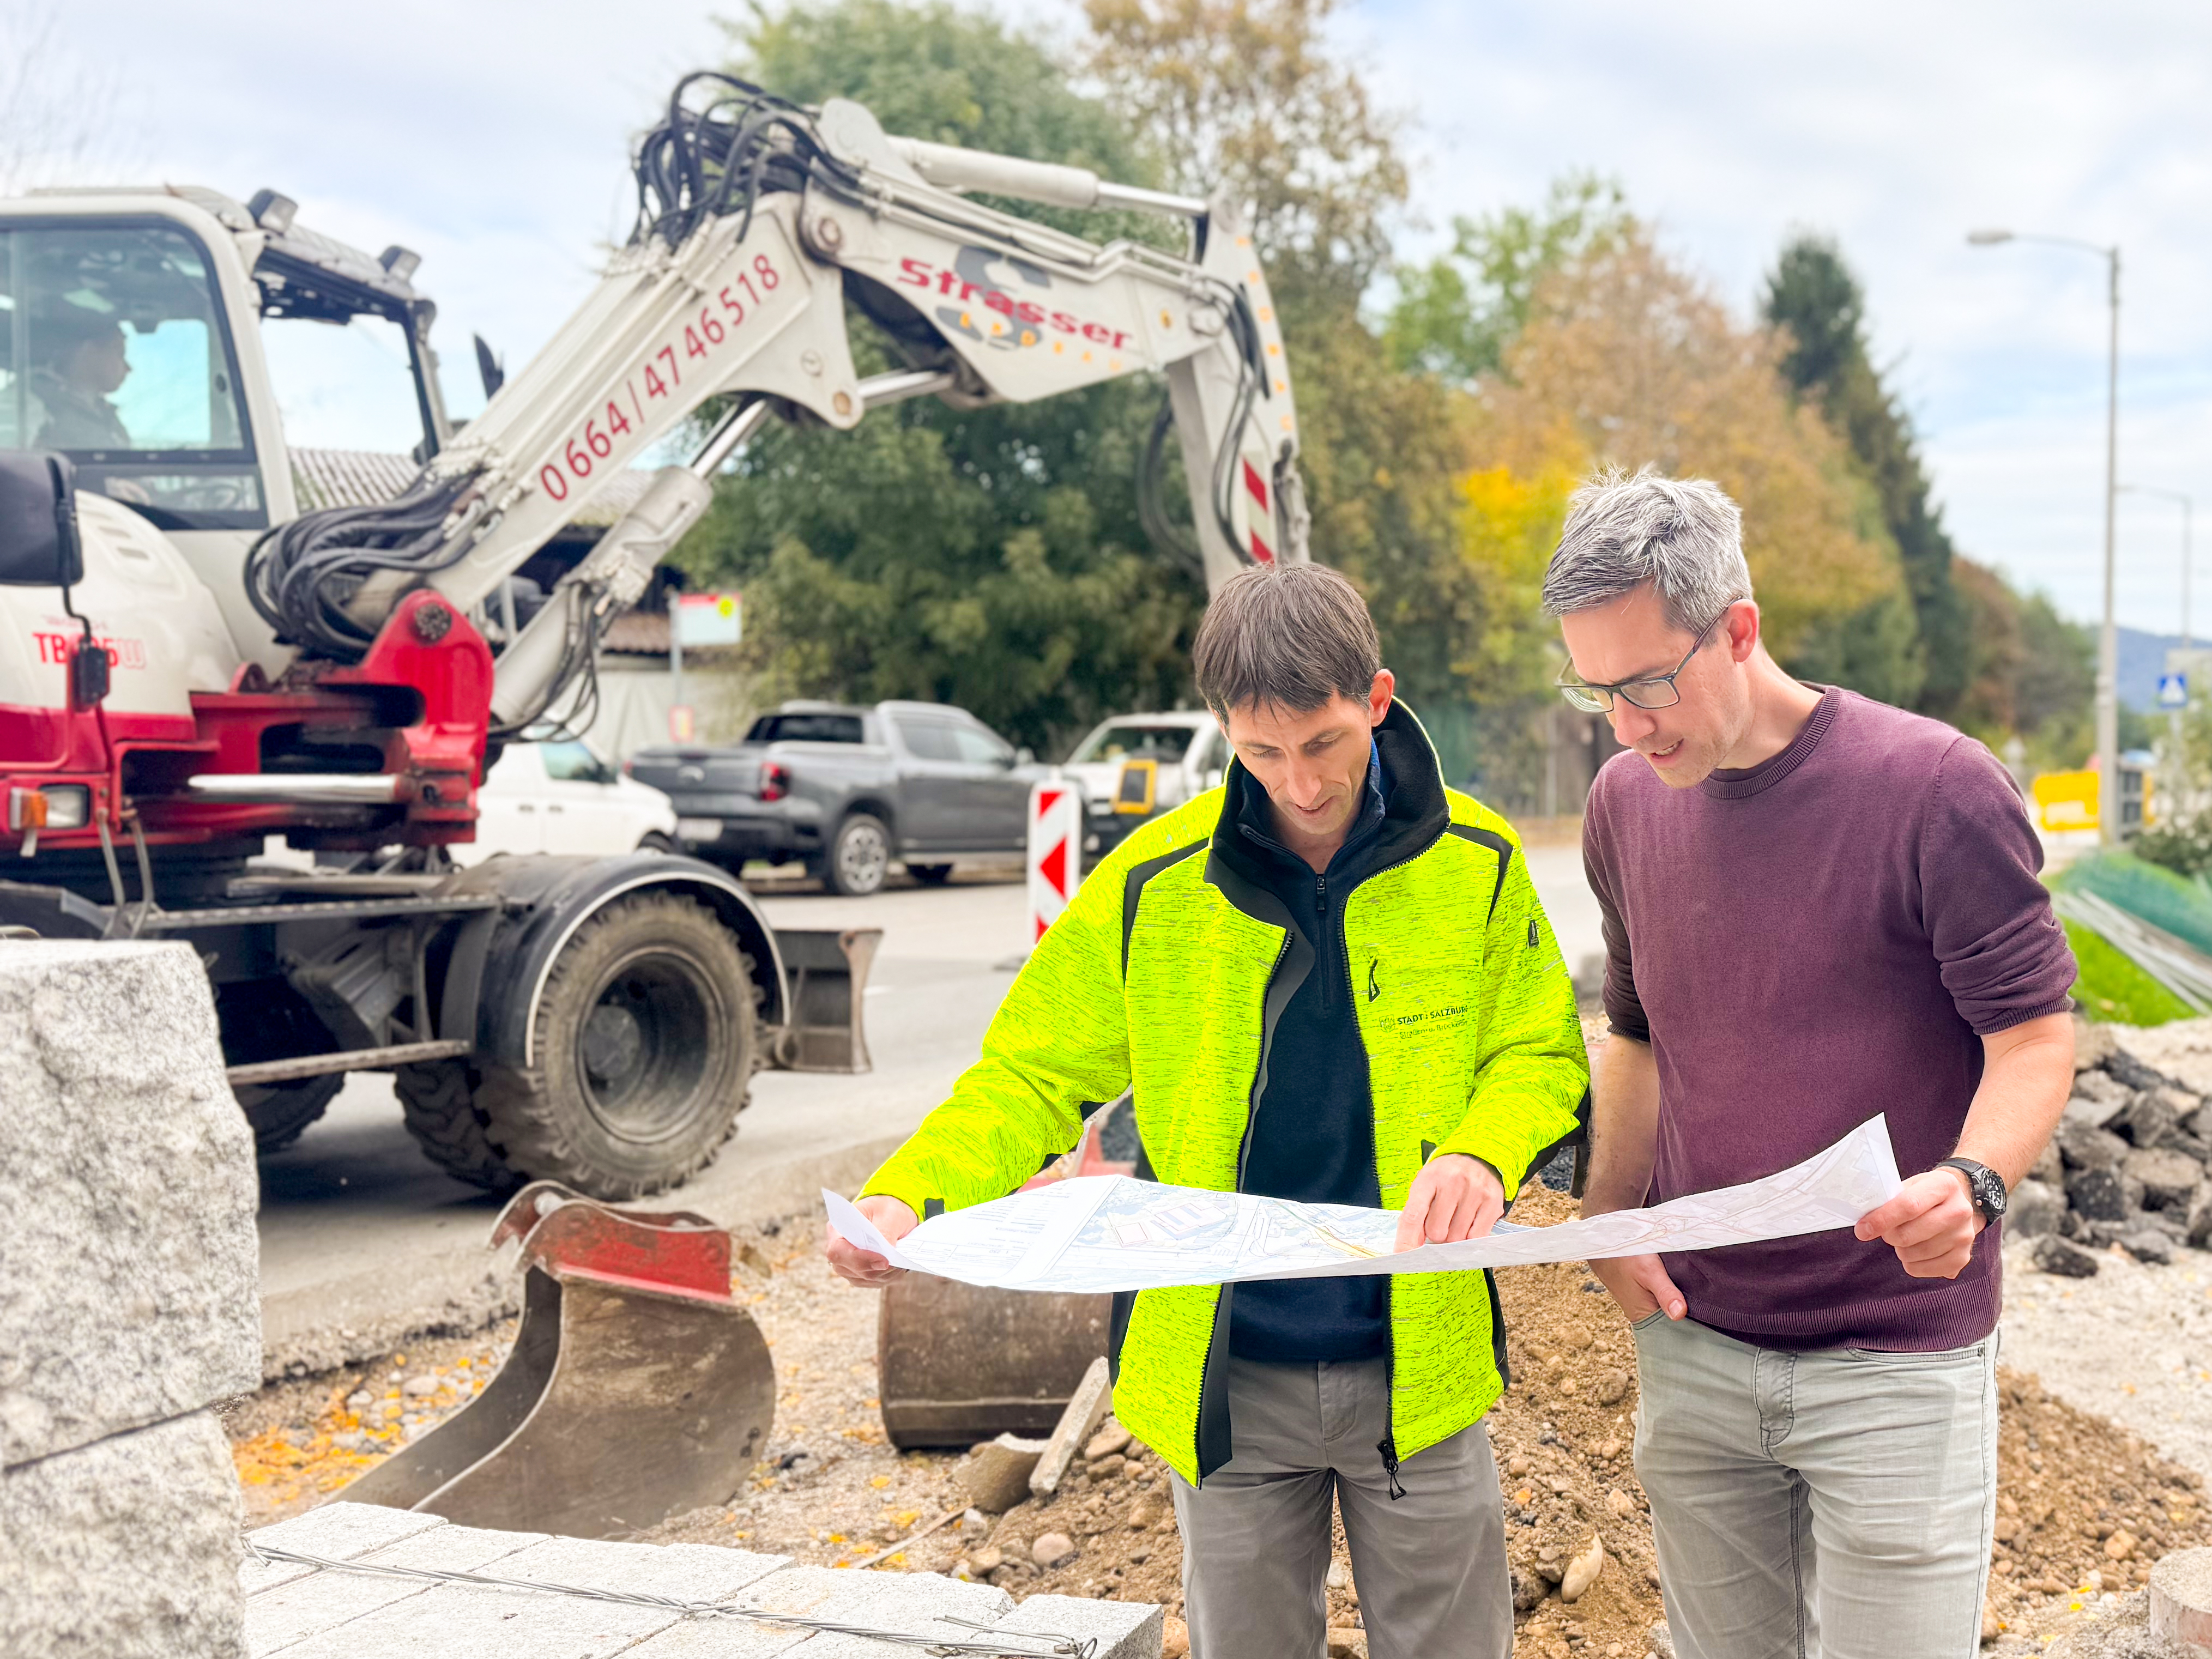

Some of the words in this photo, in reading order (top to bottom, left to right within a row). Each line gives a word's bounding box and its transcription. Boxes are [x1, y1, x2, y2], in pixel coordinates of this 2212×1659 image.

[897, 258, 1132, 349] Strasser
[540, 254, 779, 501] 0664/4746518
[1397, 1014, 1423, 1025] STADT
